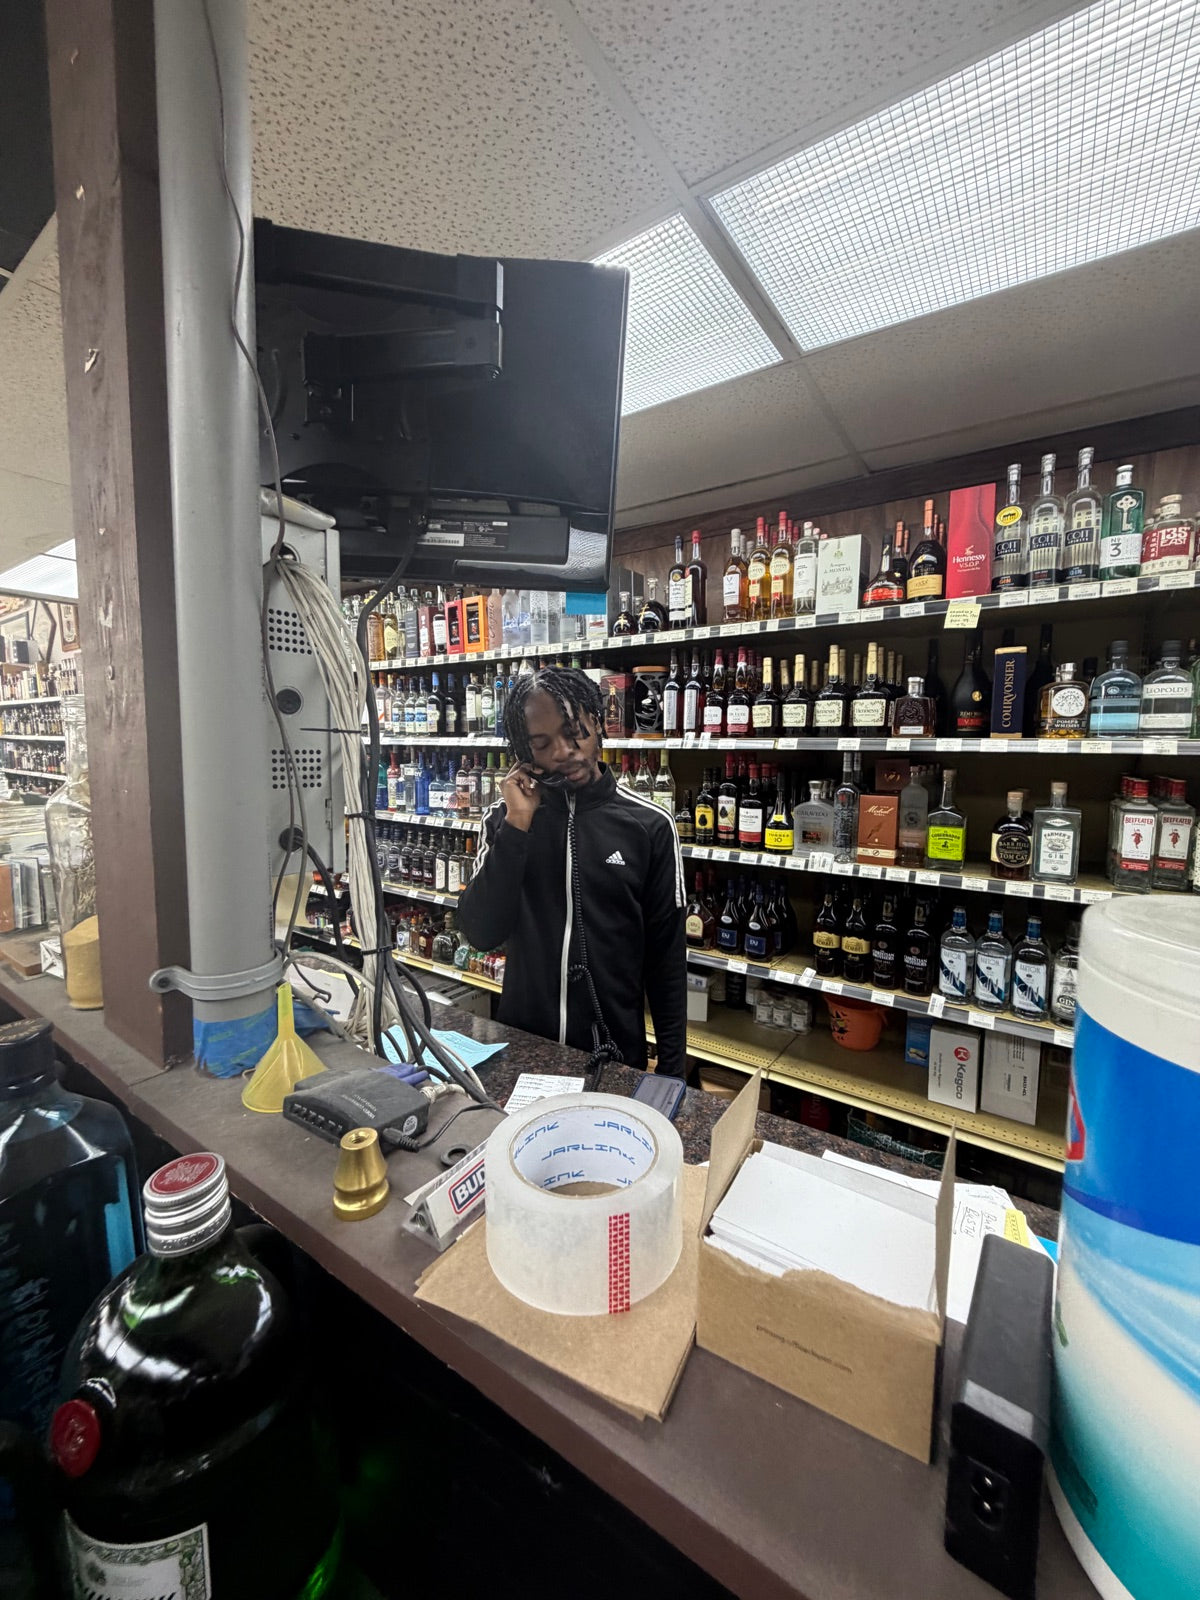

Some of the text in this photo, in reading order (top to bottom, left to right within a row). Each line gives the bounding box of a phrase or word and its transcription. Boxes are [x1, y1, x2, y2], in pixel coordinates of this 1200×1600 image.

[1032, 534, 1055, 545] COIT
[1066, 529, 1089, 541] COIT
[996, 540, 1017, 551] COIT
[1160, 538, 1187, 548] EAST
[1109, 542, 1122, 558] 3
[952, 553, 986, 564] Hennessy
[1001, 658, 1017, 728] COURVOISIER
[1124, 816, 1154, 825] BEEFEATER
[1162, 816, 1192, 826] BEEFEATER
[1043, 832, 1071, 840] FARMER'S
[903, 955, 928, 963] CHRISTIAN
[978, 975, 999, 994] GIN
[1017, 983, 1039, 1003] GIN
[1059, 998, 1075, 1007] GIN
[954, 1063, 967, 1100] Kegco
[541, 1143, 636, 1165] JARLINK
[541, 1170, 585, 1188] INK
